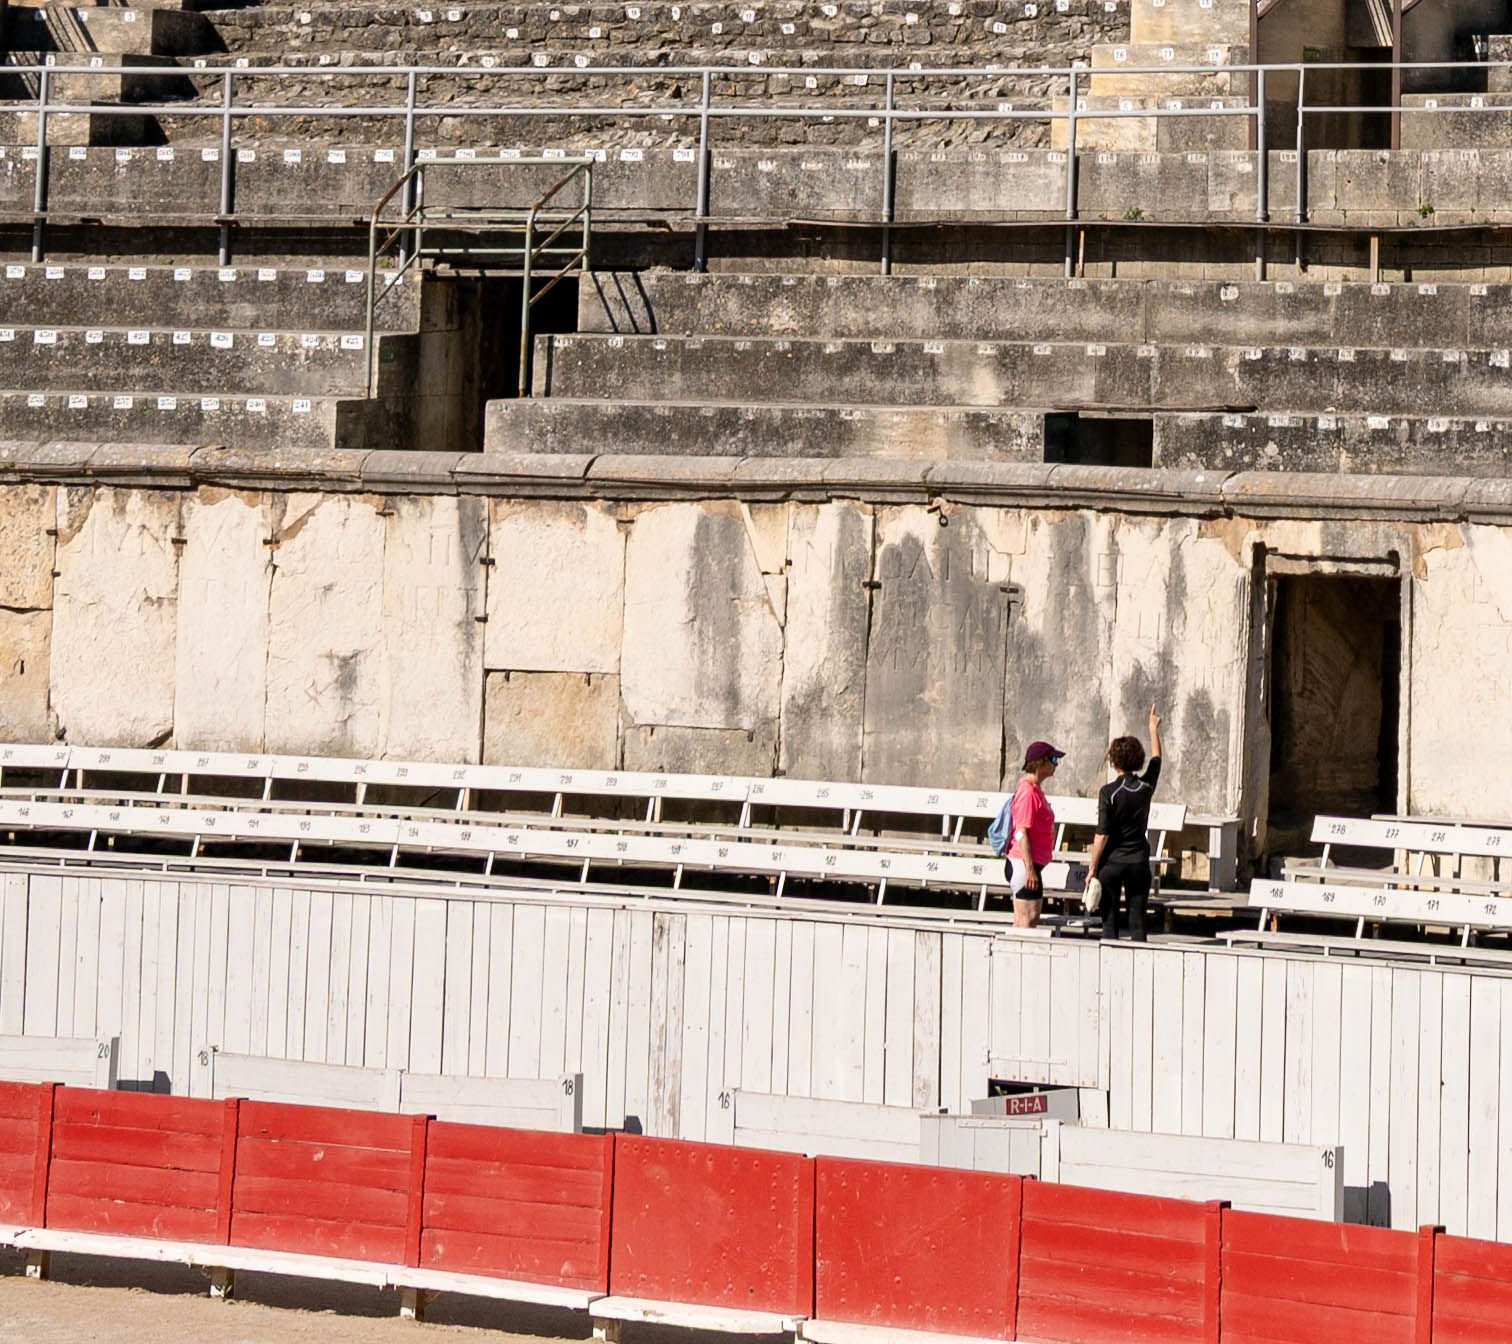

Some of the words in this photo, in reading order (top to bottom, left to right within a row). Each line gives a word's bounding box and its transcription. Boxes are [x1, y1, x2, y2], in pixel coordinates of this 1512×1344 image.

[1374, 896, 1386, 906] 170
[1427, 900, 1439, 910] 171
[1484, 904, 1496, 915] 172
[98, 1043, 109, 1058] 20
[562, 1080, 573, 1095] 18
[718, 1092, 730, 1109] 16
[1010, 1098, 1041, 1113] R-I-A
[1322, 1150, 1333, 1168] 16
